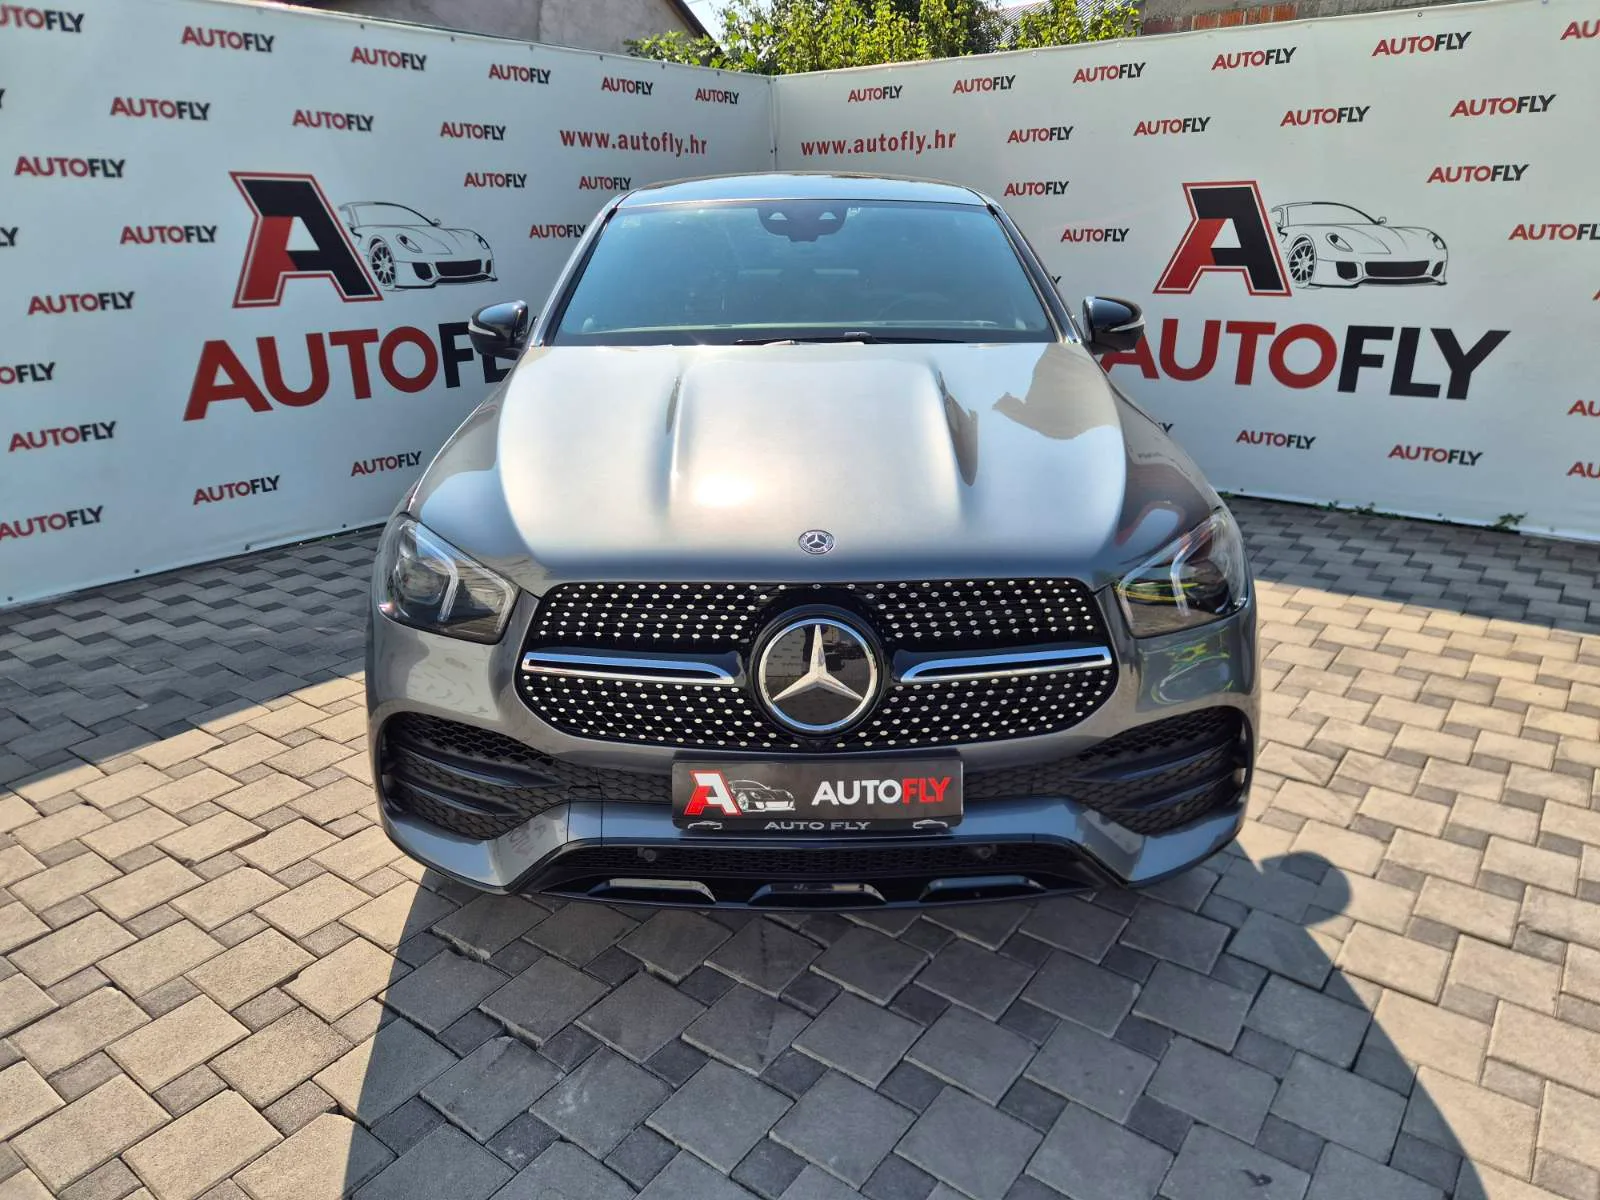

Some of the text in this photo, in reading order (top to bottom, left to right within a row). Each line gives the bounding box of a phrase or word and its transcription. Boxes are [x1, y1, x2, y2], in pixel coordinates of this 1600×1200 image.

[182, 27, 274, 53] AUTOFLY
[1372, 32, 1472, 56] AUTOFLY
[351, 47, 427, 71] AUTOFLY
[1212, 47, 1296, 70] AUTOFLY
[489, 64, 551, 84] AUTOFLY
[1073, 62, 1146, 83] AUTOFLY
[601, 77, 653, 95] AUTOFLY
[848, 85, 903, 102] AUTOFLY
[953, 75, 1016, 93] AUTOFLY
[696, 88, 739, 104] AUTOFLY
[1450, 94, 1556, 117] AUTOFLY
[110, 97, 210, 120] AUTOFLY
[1280, 106, 1370, 126] AUTOFLY
[293, 110, 374, 132] AUTOFLY
[441, 122, 506, 141] AUTOFLY
[1134, 117, 1211, 136] AUTOFLY
[560, 130, 706, 157] www.autofly.hr
[801, 130, 956, 156] www.autofly.hr
[1008, 126, 1074, 143] AUTOFLY
[15, 157, 125, 178] AUTOFLY
[1427, 164, 1529, 183] AUTOFLY
[464, 173, 527, 188] AUTOFLY
[579, 176, 631, 190] AUTOFLY
[1004, 181, 1069, 196] AUTOFLY
[120, 225, 217, 244] AUTOFLY
[1061, 228, 1129, 242] AUTOFLY
[1509, 224, 1600, 240] AUTOFL
[28, 291, 135, 314] AUTOFLY
[184, 321, 511, 421] AUTOFL
[10, 421, 116, 451] AUTOFLY
[1236, 430, 1316, 450] AUTOFLY
[351, 451, 422, 476] AUTOFLY
[1388, 445, 1483, 466] AUTOFLY
[194, 475, 280, 505] AUTOFLY
[0, 505, 103, 540] AUTOFLY
[812, 777, 950, 805] AUTOFLY
[763, 821, 871, 831] AUTO FLY
